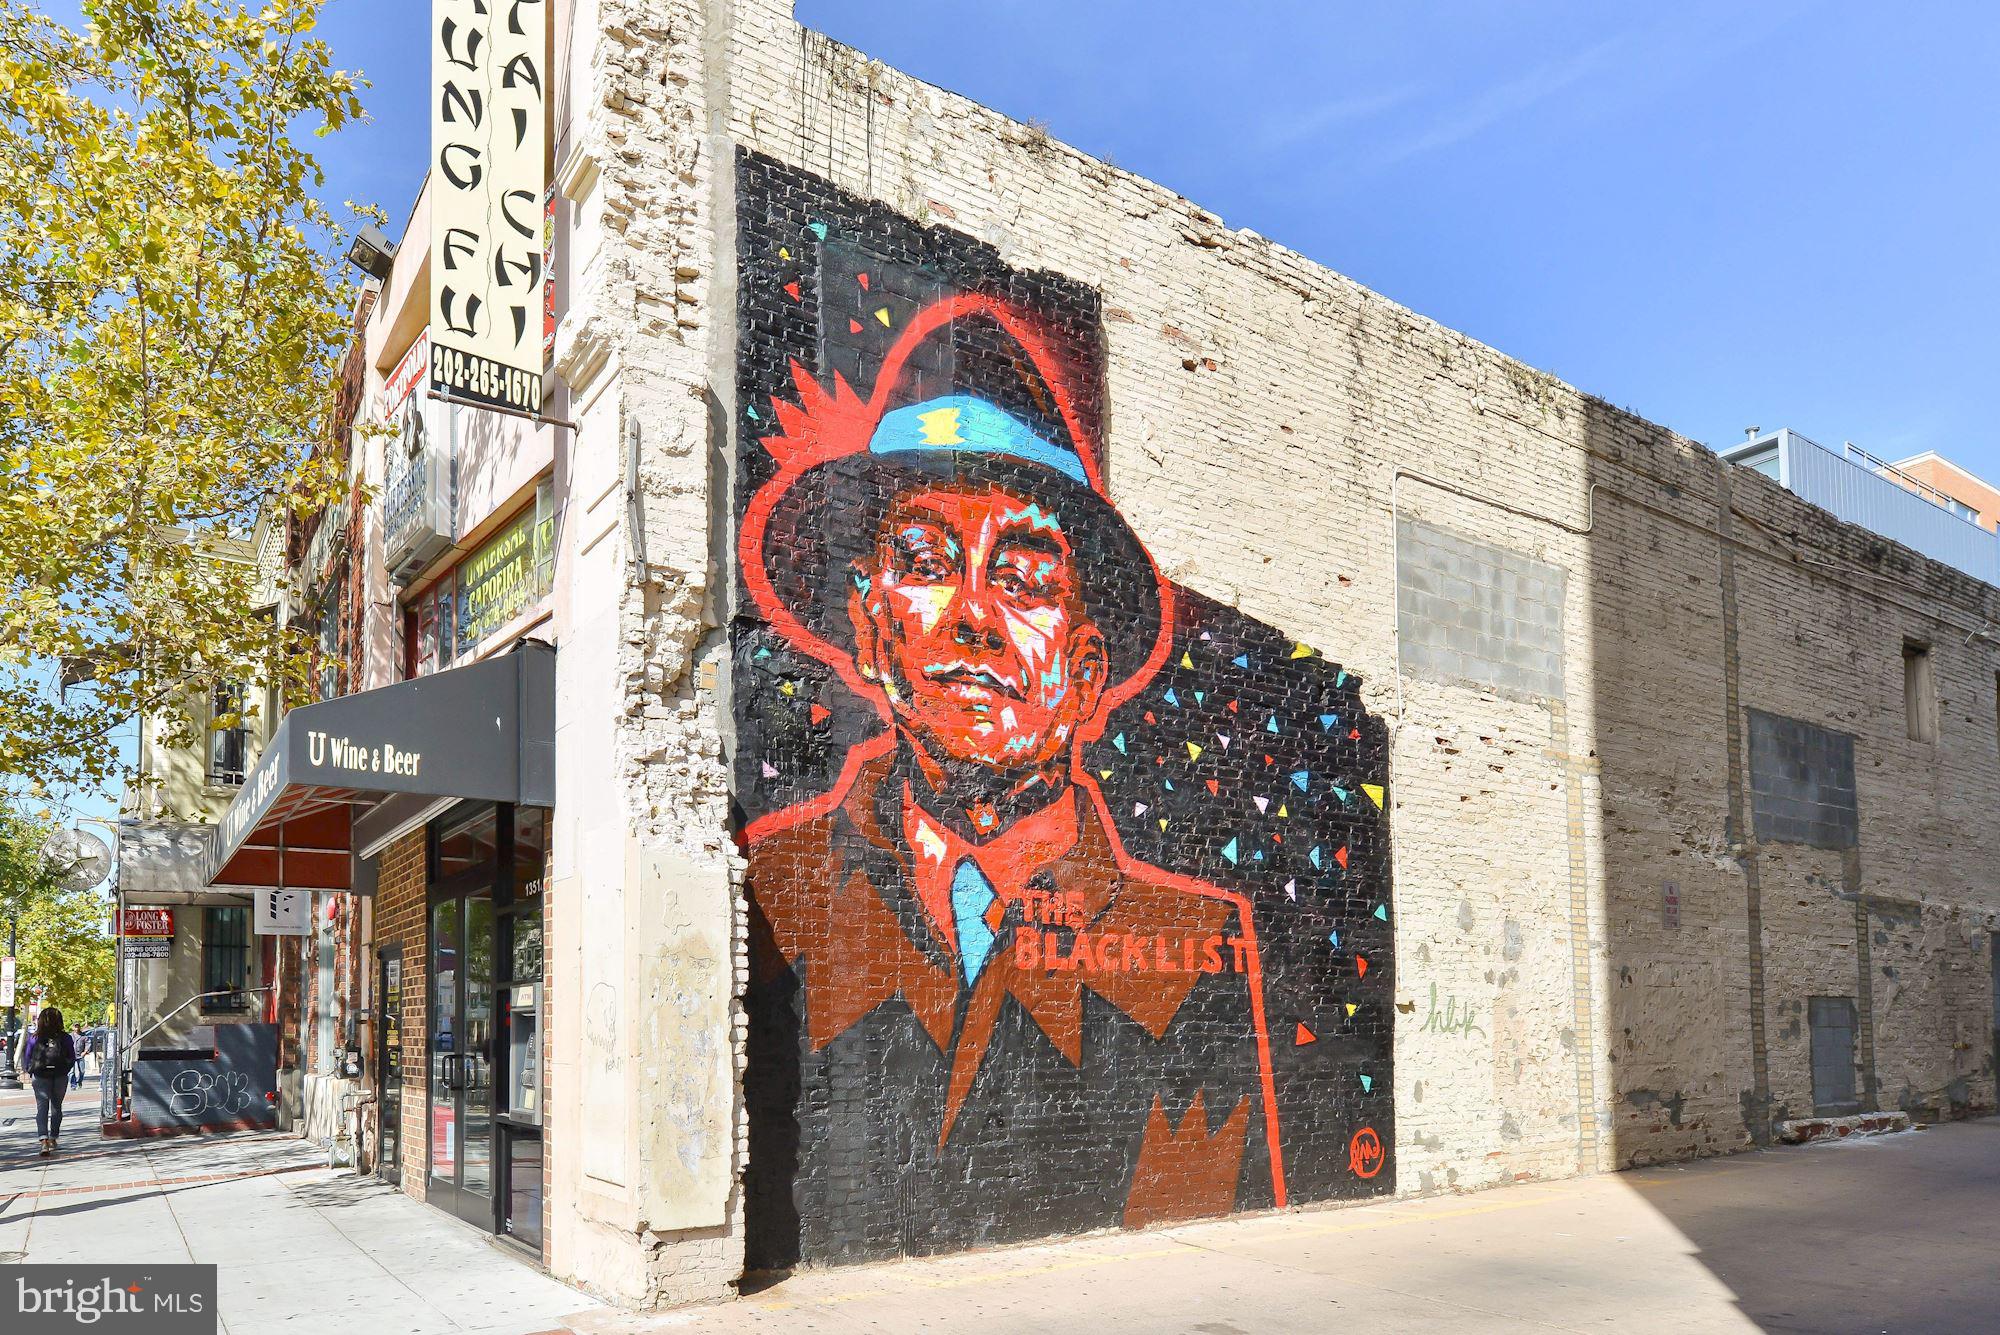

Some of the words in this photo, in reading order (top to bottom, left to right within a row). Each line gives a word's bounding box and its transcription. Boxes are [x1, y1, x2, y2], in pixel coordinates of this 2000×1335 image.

[441, 0, 488, 192] UNG
[498, 0, 542, 152] TAI
[440, 228, 483, 338] FU
[495, 189, 541, 351] CHI
[434, 345, 540, 411] 202-265-1670
[466, 525, 526, 587] UNIVERSAL
[469, 555, 523, 616] CAPOEIRA
[308, 731, 326, 766] U
[330, 737, 368, 771] Wine
[371, 748, 380, 772] &
[384, 744, 421, 776] Beer
[226, 811, 233, 847] U
[234, 798, 250, 837] Wine
[251, 787, 257, 815] &
[257, 751, 280, 805] Beer
[135, 911, 158, 920] LONG
[160, 911, 168, 920] &
[135, 920, 168, 930] FOSTER
[1019, 889, 1085, 928] THE
[1016, 926, 1250, 974] BLACKLIST
[520, 993, 532, 1001] ATM
